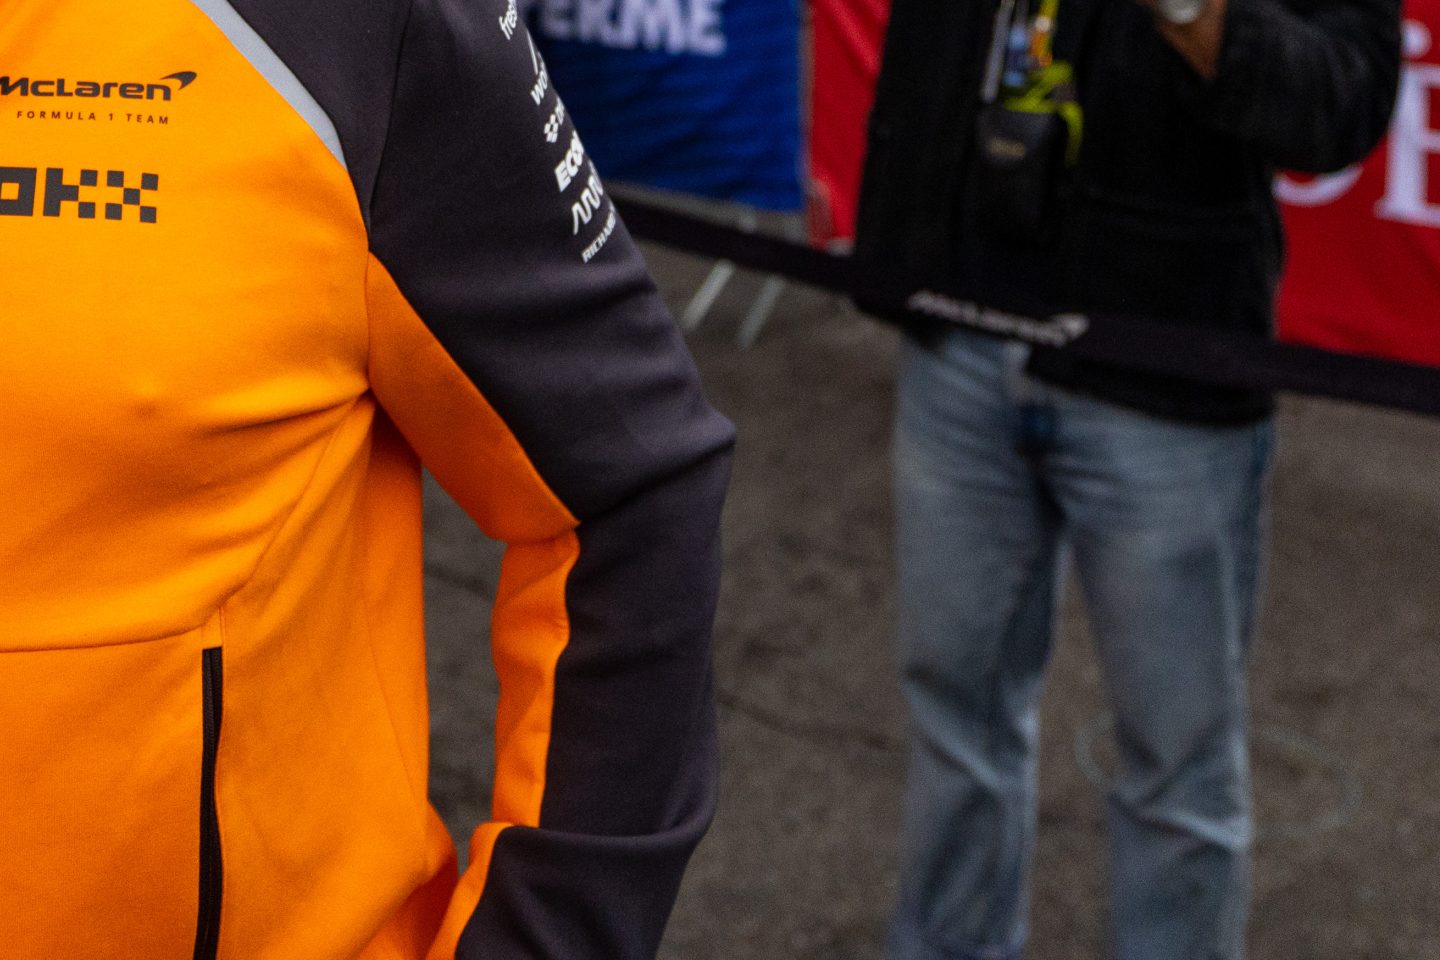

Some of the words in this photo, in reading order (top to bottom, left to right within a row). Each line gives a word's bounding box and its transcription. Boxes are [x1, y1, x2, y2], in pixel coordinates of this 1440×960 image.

[16, 110, 97, 122] FORMULA
[108, 112, 116, 122] 1
[126, 114, 170, 125] TEAM
